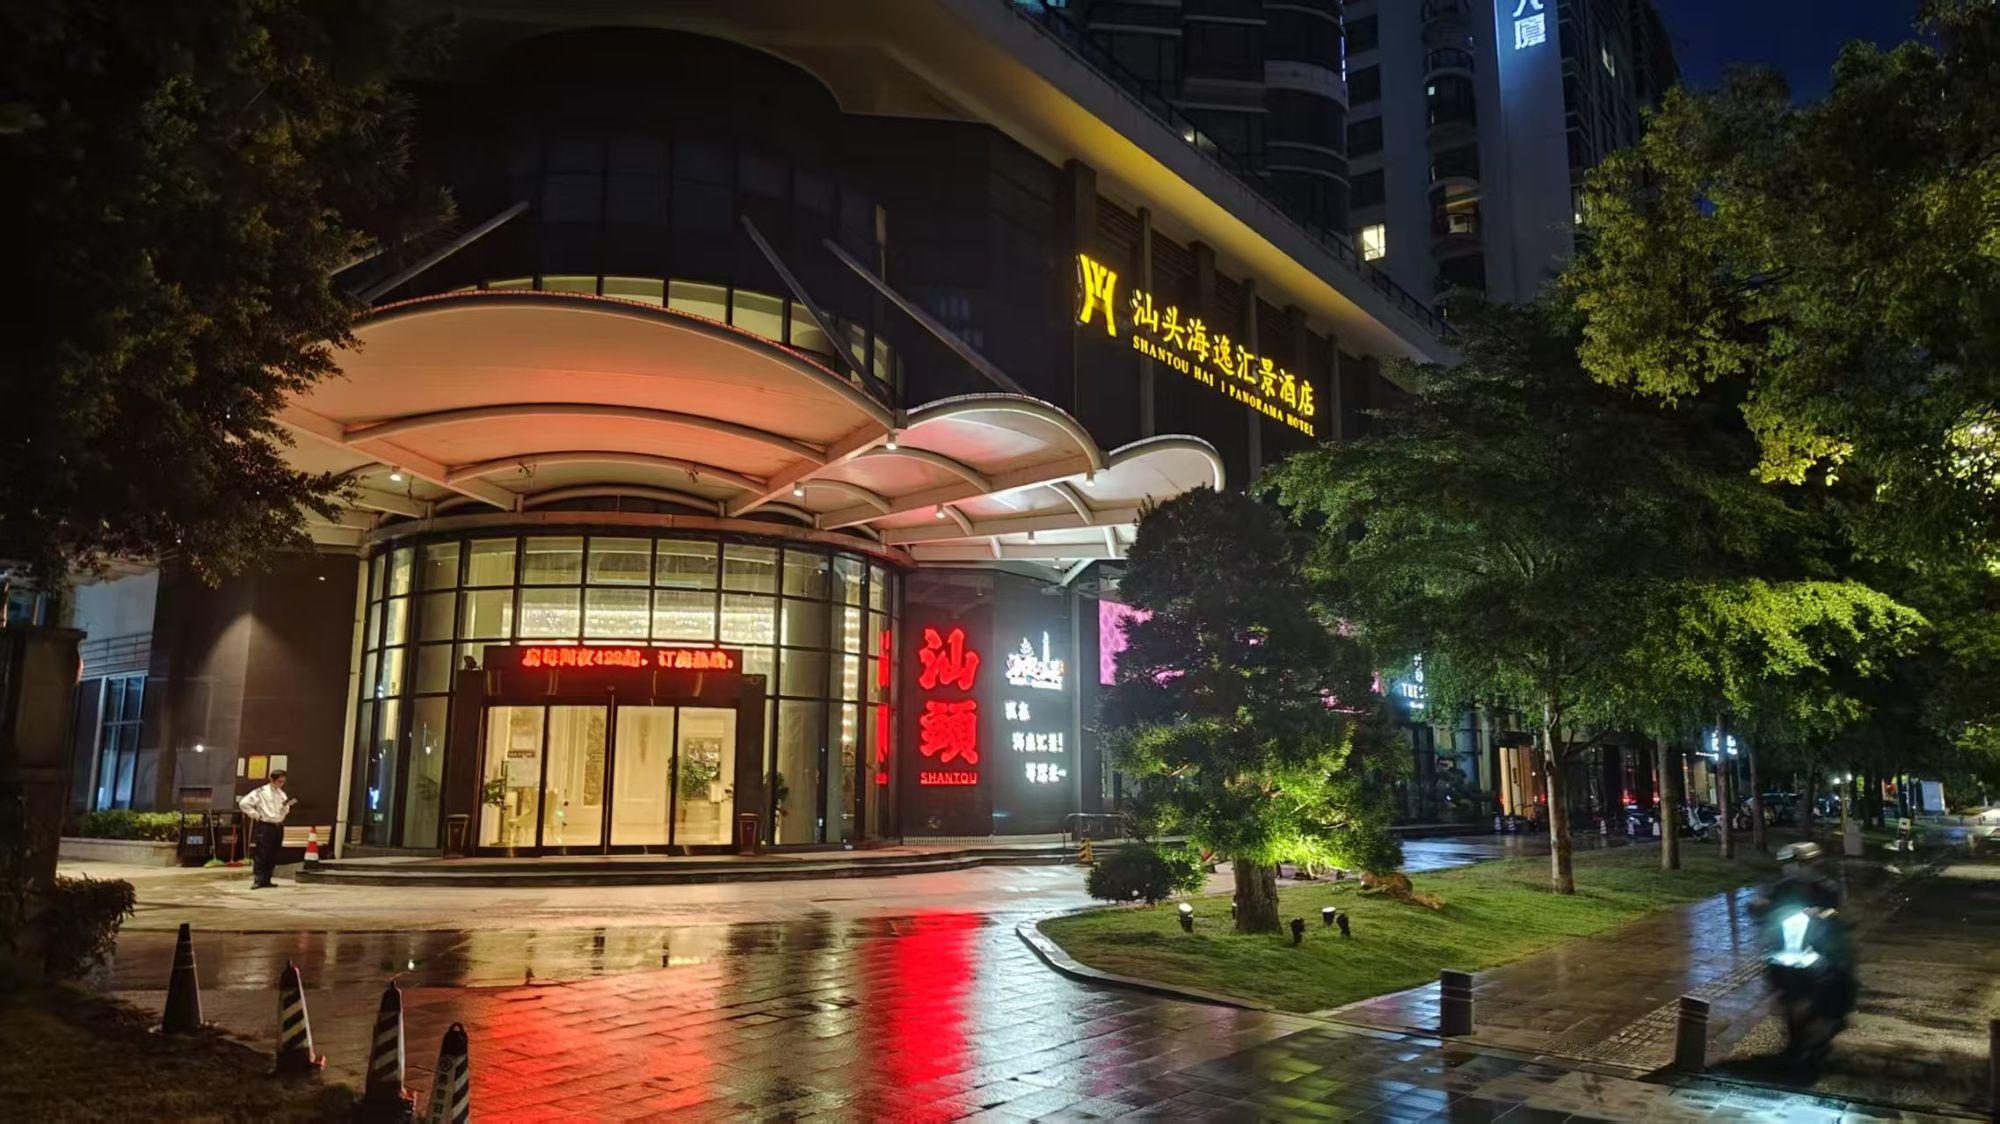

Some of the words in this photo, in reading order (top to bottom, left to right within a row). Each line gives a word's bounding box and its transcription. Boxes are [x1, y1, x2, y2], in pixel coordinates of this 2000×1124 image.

[1131, 289, 1315, 416] 汕头海逸汇景酒店
[1133, 335, 1189, 374] SHANTOU
[1193, 366, 1214, 388] HAI
[1229, 385, 1284, 422] PANORAMA
[1287, 414, 1315, 437] HOTEL
[920, 772, 977, 785] SHANTOU
